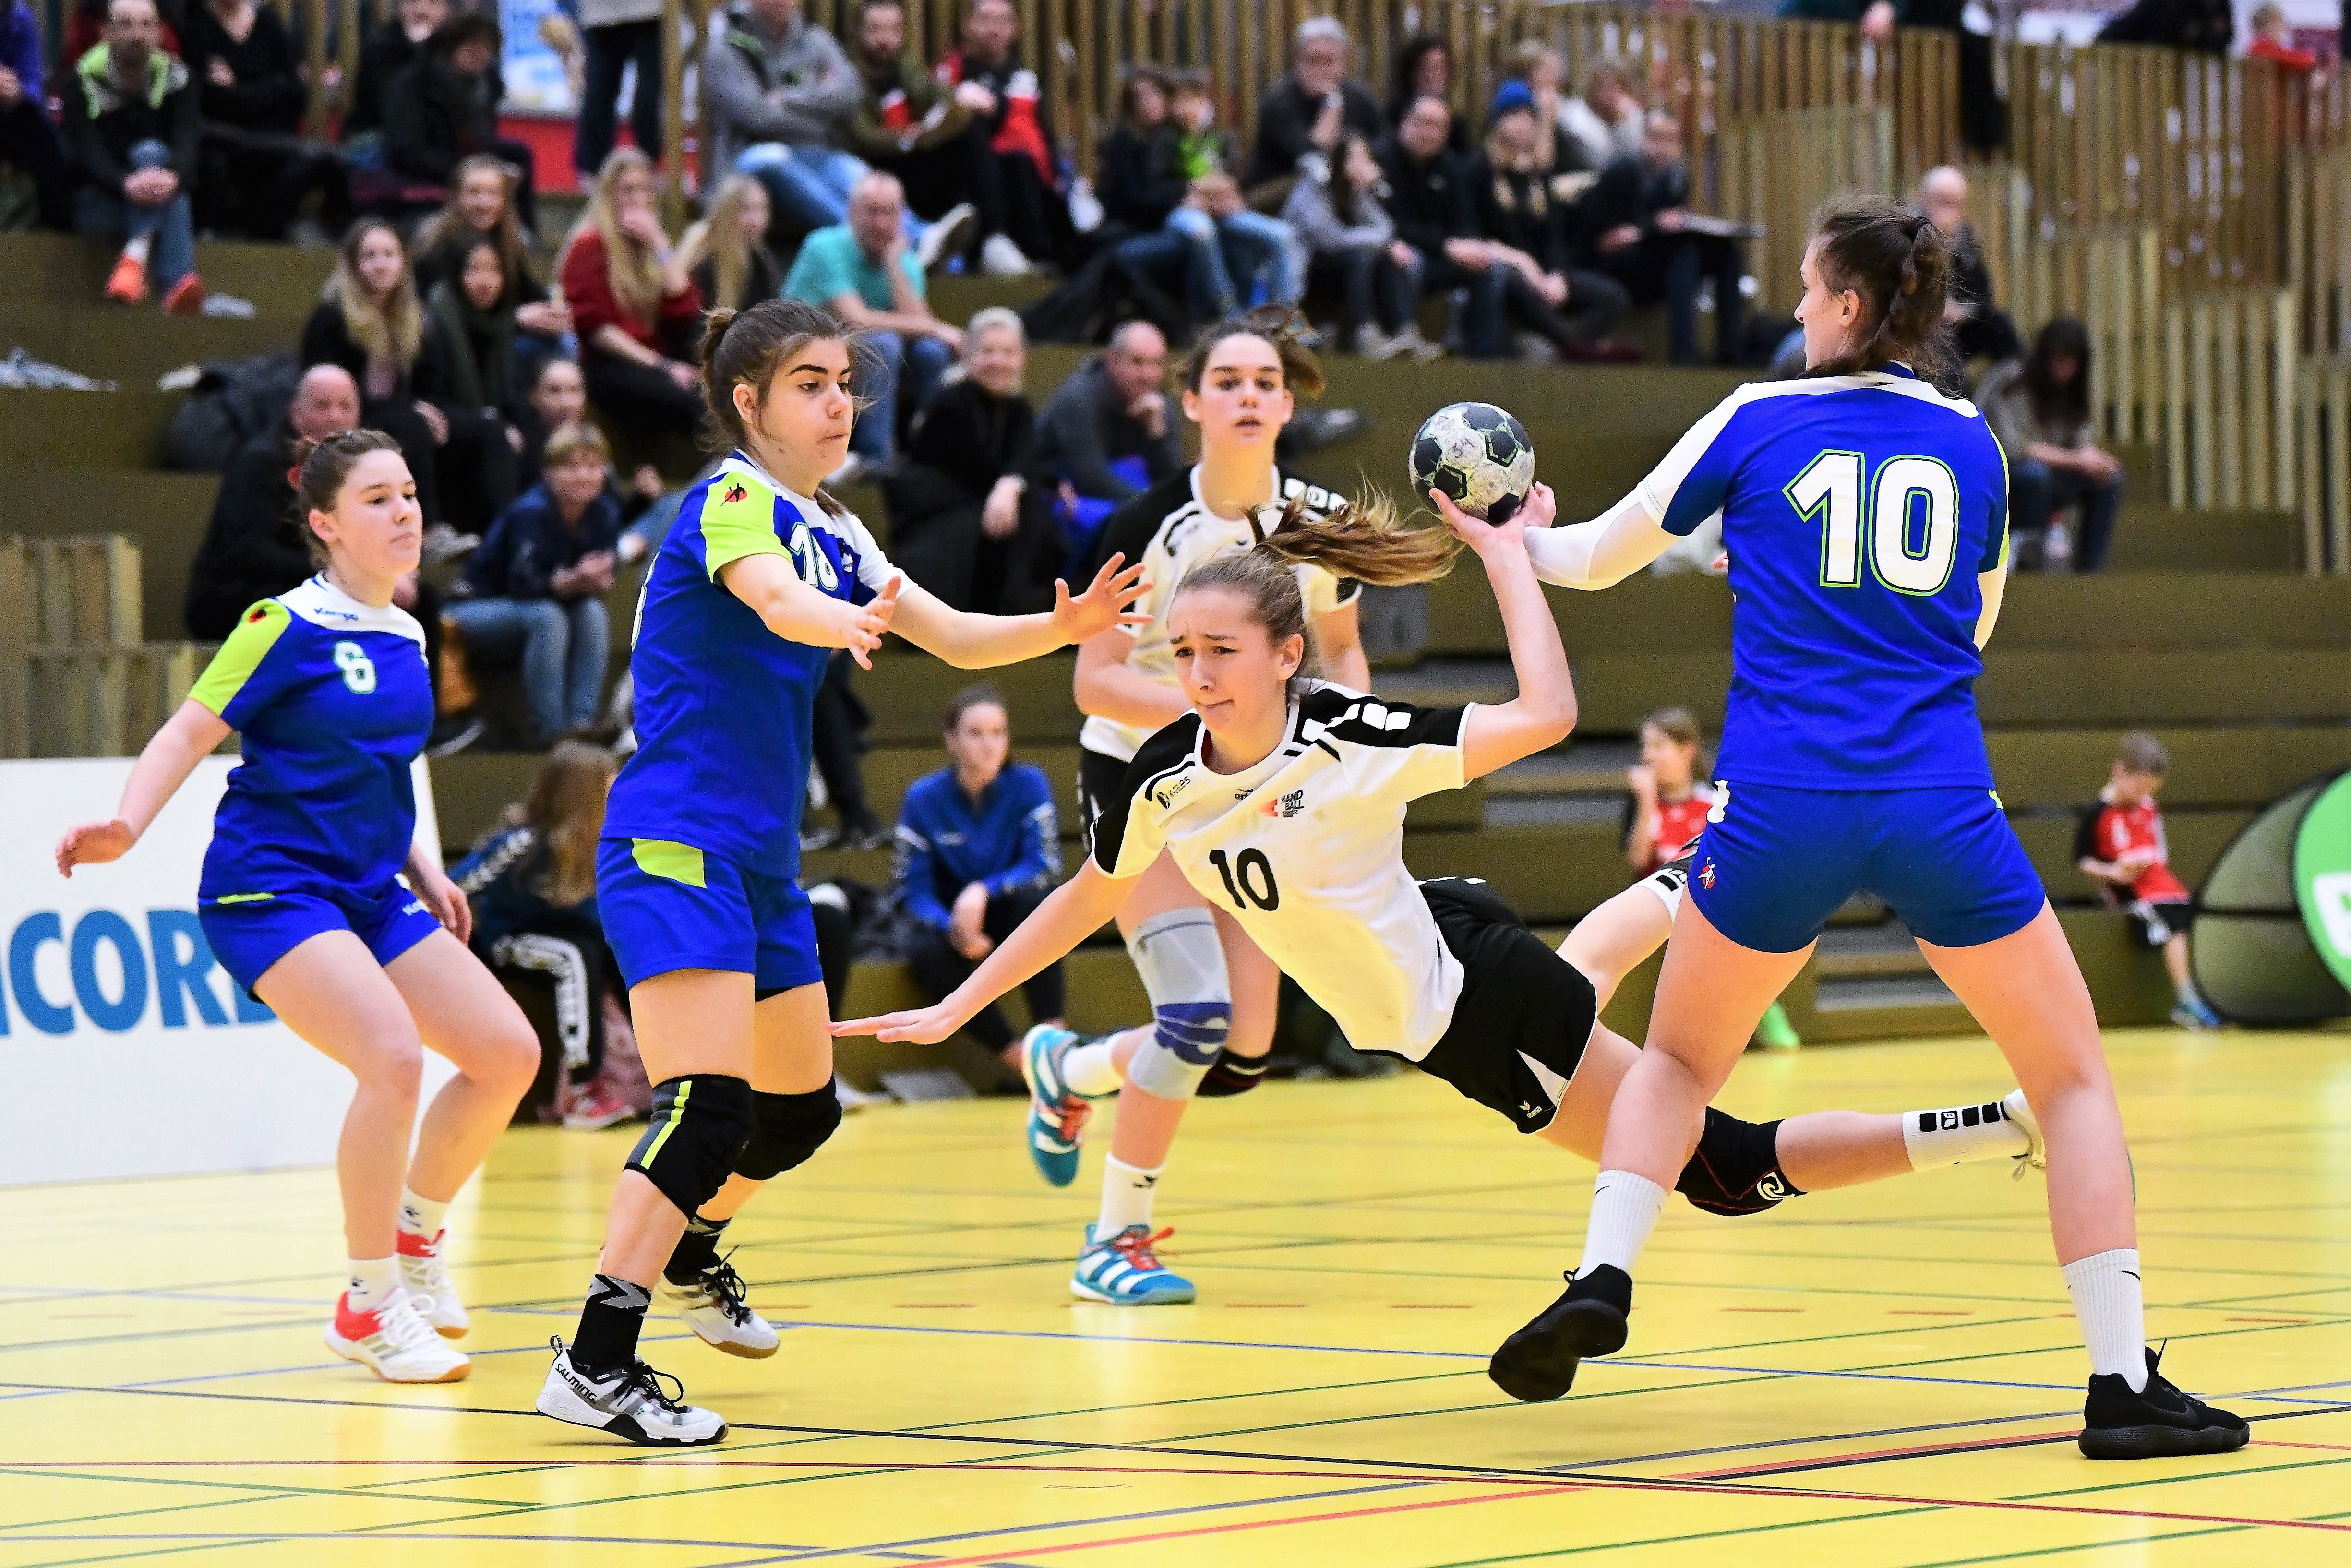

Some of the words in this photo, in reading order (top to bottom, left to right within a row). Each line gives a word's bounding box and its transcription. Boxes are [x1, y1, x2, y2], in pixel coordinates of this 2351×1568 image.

[1782, 449, 1959, 597] 10
[332, 640, 378, 695] 6
[1209, 848, 1279, 911] 10
[0, 907, 278, 1037] COR
[555, 1363, 598, 1404] SALMING
